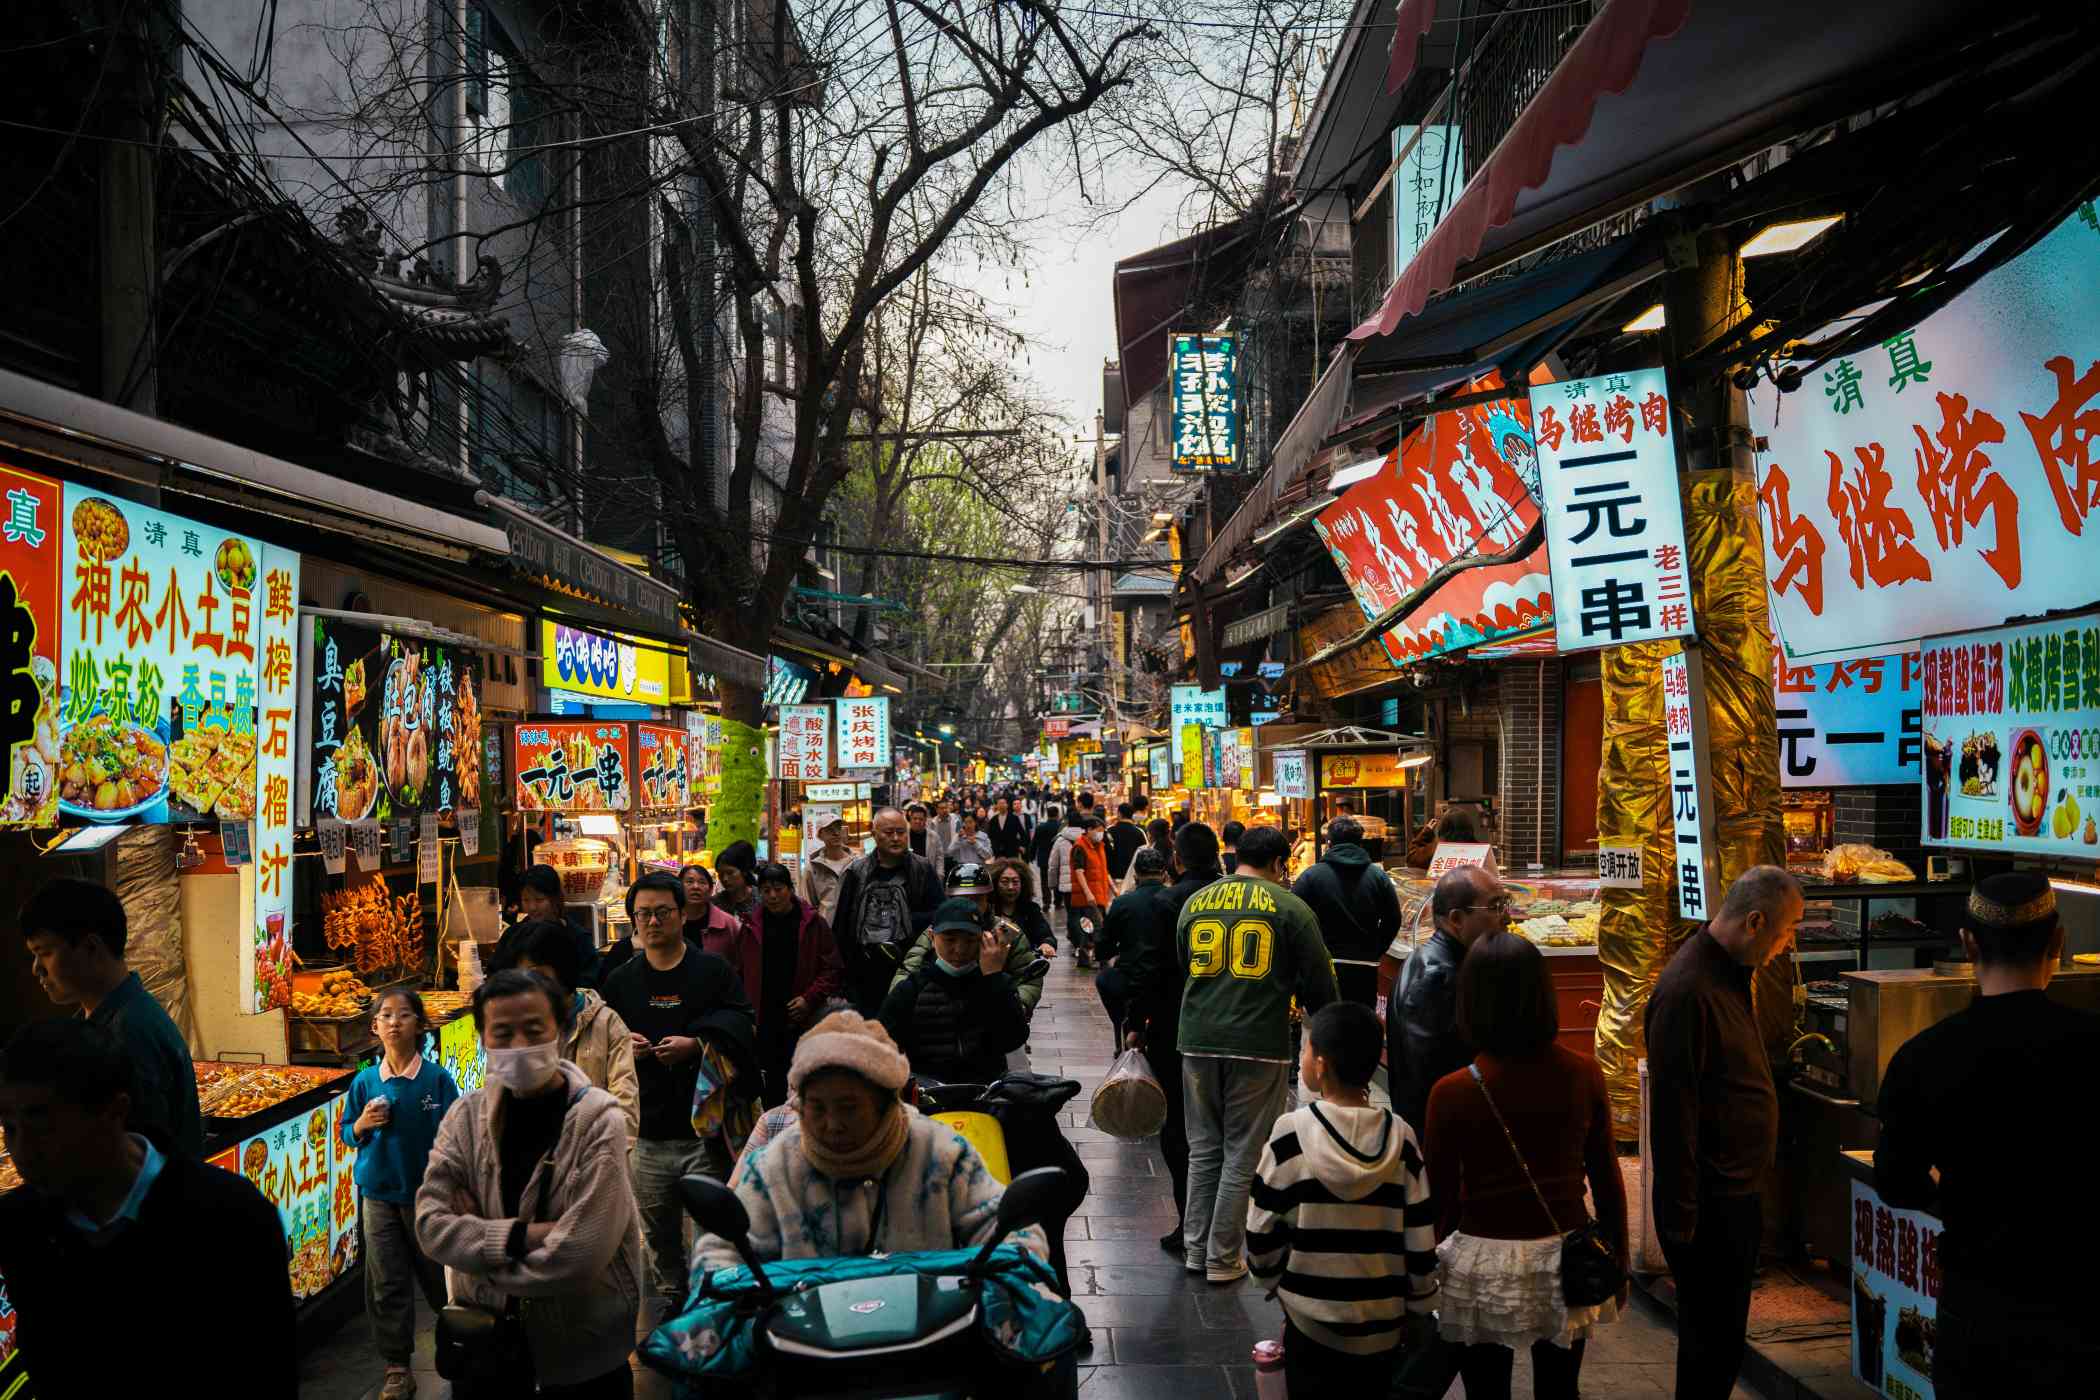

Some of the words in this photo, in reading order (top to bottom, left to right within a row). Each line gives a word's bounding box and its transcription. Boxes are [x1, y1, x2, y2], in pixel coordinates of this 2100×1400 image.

[1564, 374, 1631, 399] 清真
[1825, 328, 1933, 415] 清真
[1535, 390, 1669, 452] 马继烤肉
[1760, 355, 2100, 616] 马继烤肉
[3, 488, 46, 548] 真
[144, 520, 203, 558] 清真
[1559, 449, 1652, 641] 一元一串
[71, 541, 256, 664] 神农小土豆
[1653, 543, 1690, 632] 老三样
[65, 649, 165, 730] 炒凉粉
[178, 663, 256, 736] 香豆腐
[1666, 703, 1690, 736] 烤肉
[260, 568, 295, 897] 鲜榨石榴汁
[313, 635, 344, 817] 臭豆腐
[438, 658, 456, 812] 铁板鱿鱼
[805, 716, 824, 778] 酸汤水饺
[852, 704, 876, 764] 张庆烤肉
[23, 770, 42, 798] 起
[518, 743, 623, 806] 一元一串
[641, 746, 687, 802] 一元一串
[1671, 741, 1702, 916] 一元一串
[1188, 881, 1247, 913] GOLDEN
[1247, 884, 1278, 913] AGE
[1599, 851, 1641, 881] 空调开放
[1189, 919, 1274, 980] 90
[273, 1122, 301, 1151] 清真
